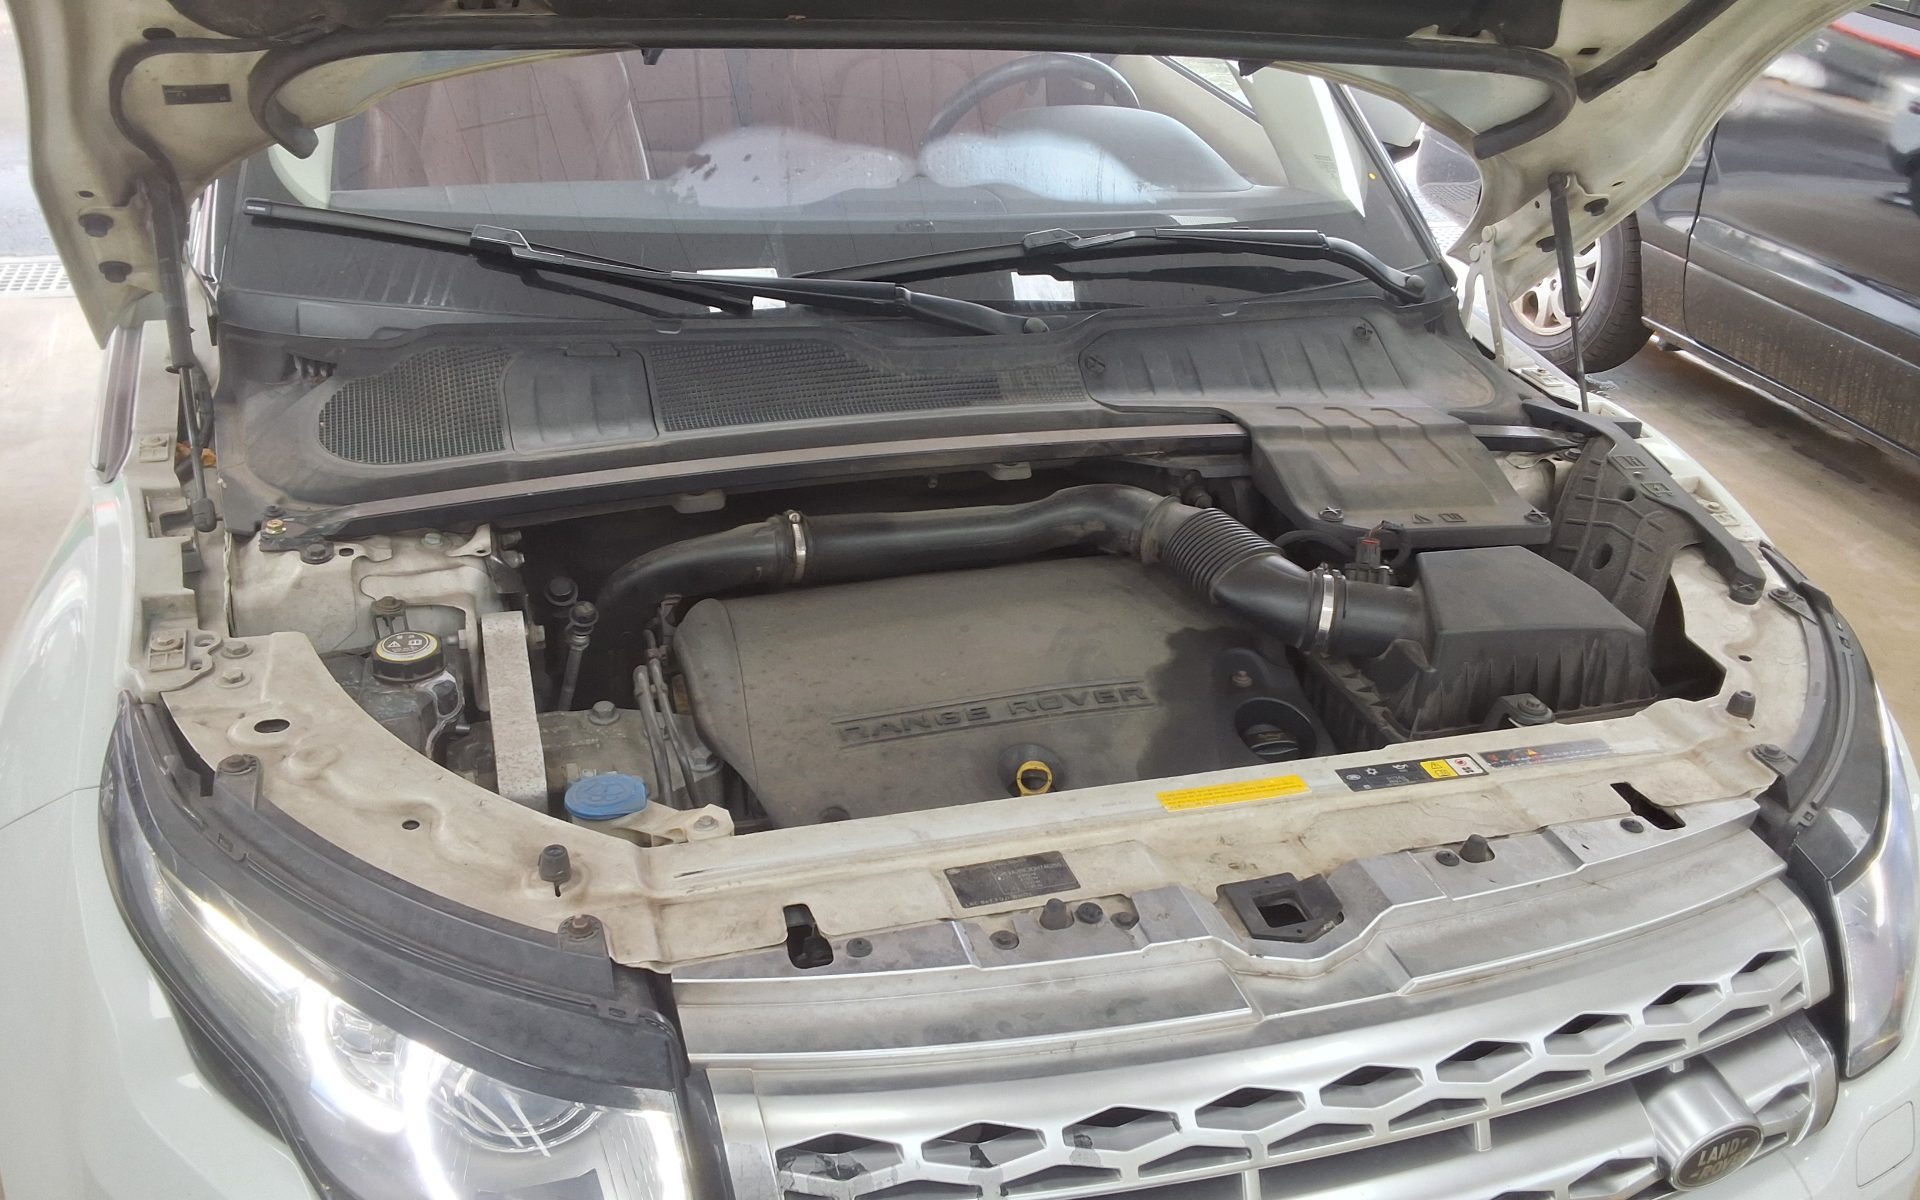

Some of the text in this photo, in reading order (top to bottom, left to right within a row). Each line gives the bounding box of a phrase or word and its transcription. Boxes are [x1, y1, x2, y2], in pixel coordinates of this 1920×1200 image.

[839, 686, 1147, 741] RANGE ROVER
[1698, 1138, 1740, 1167] LAND
